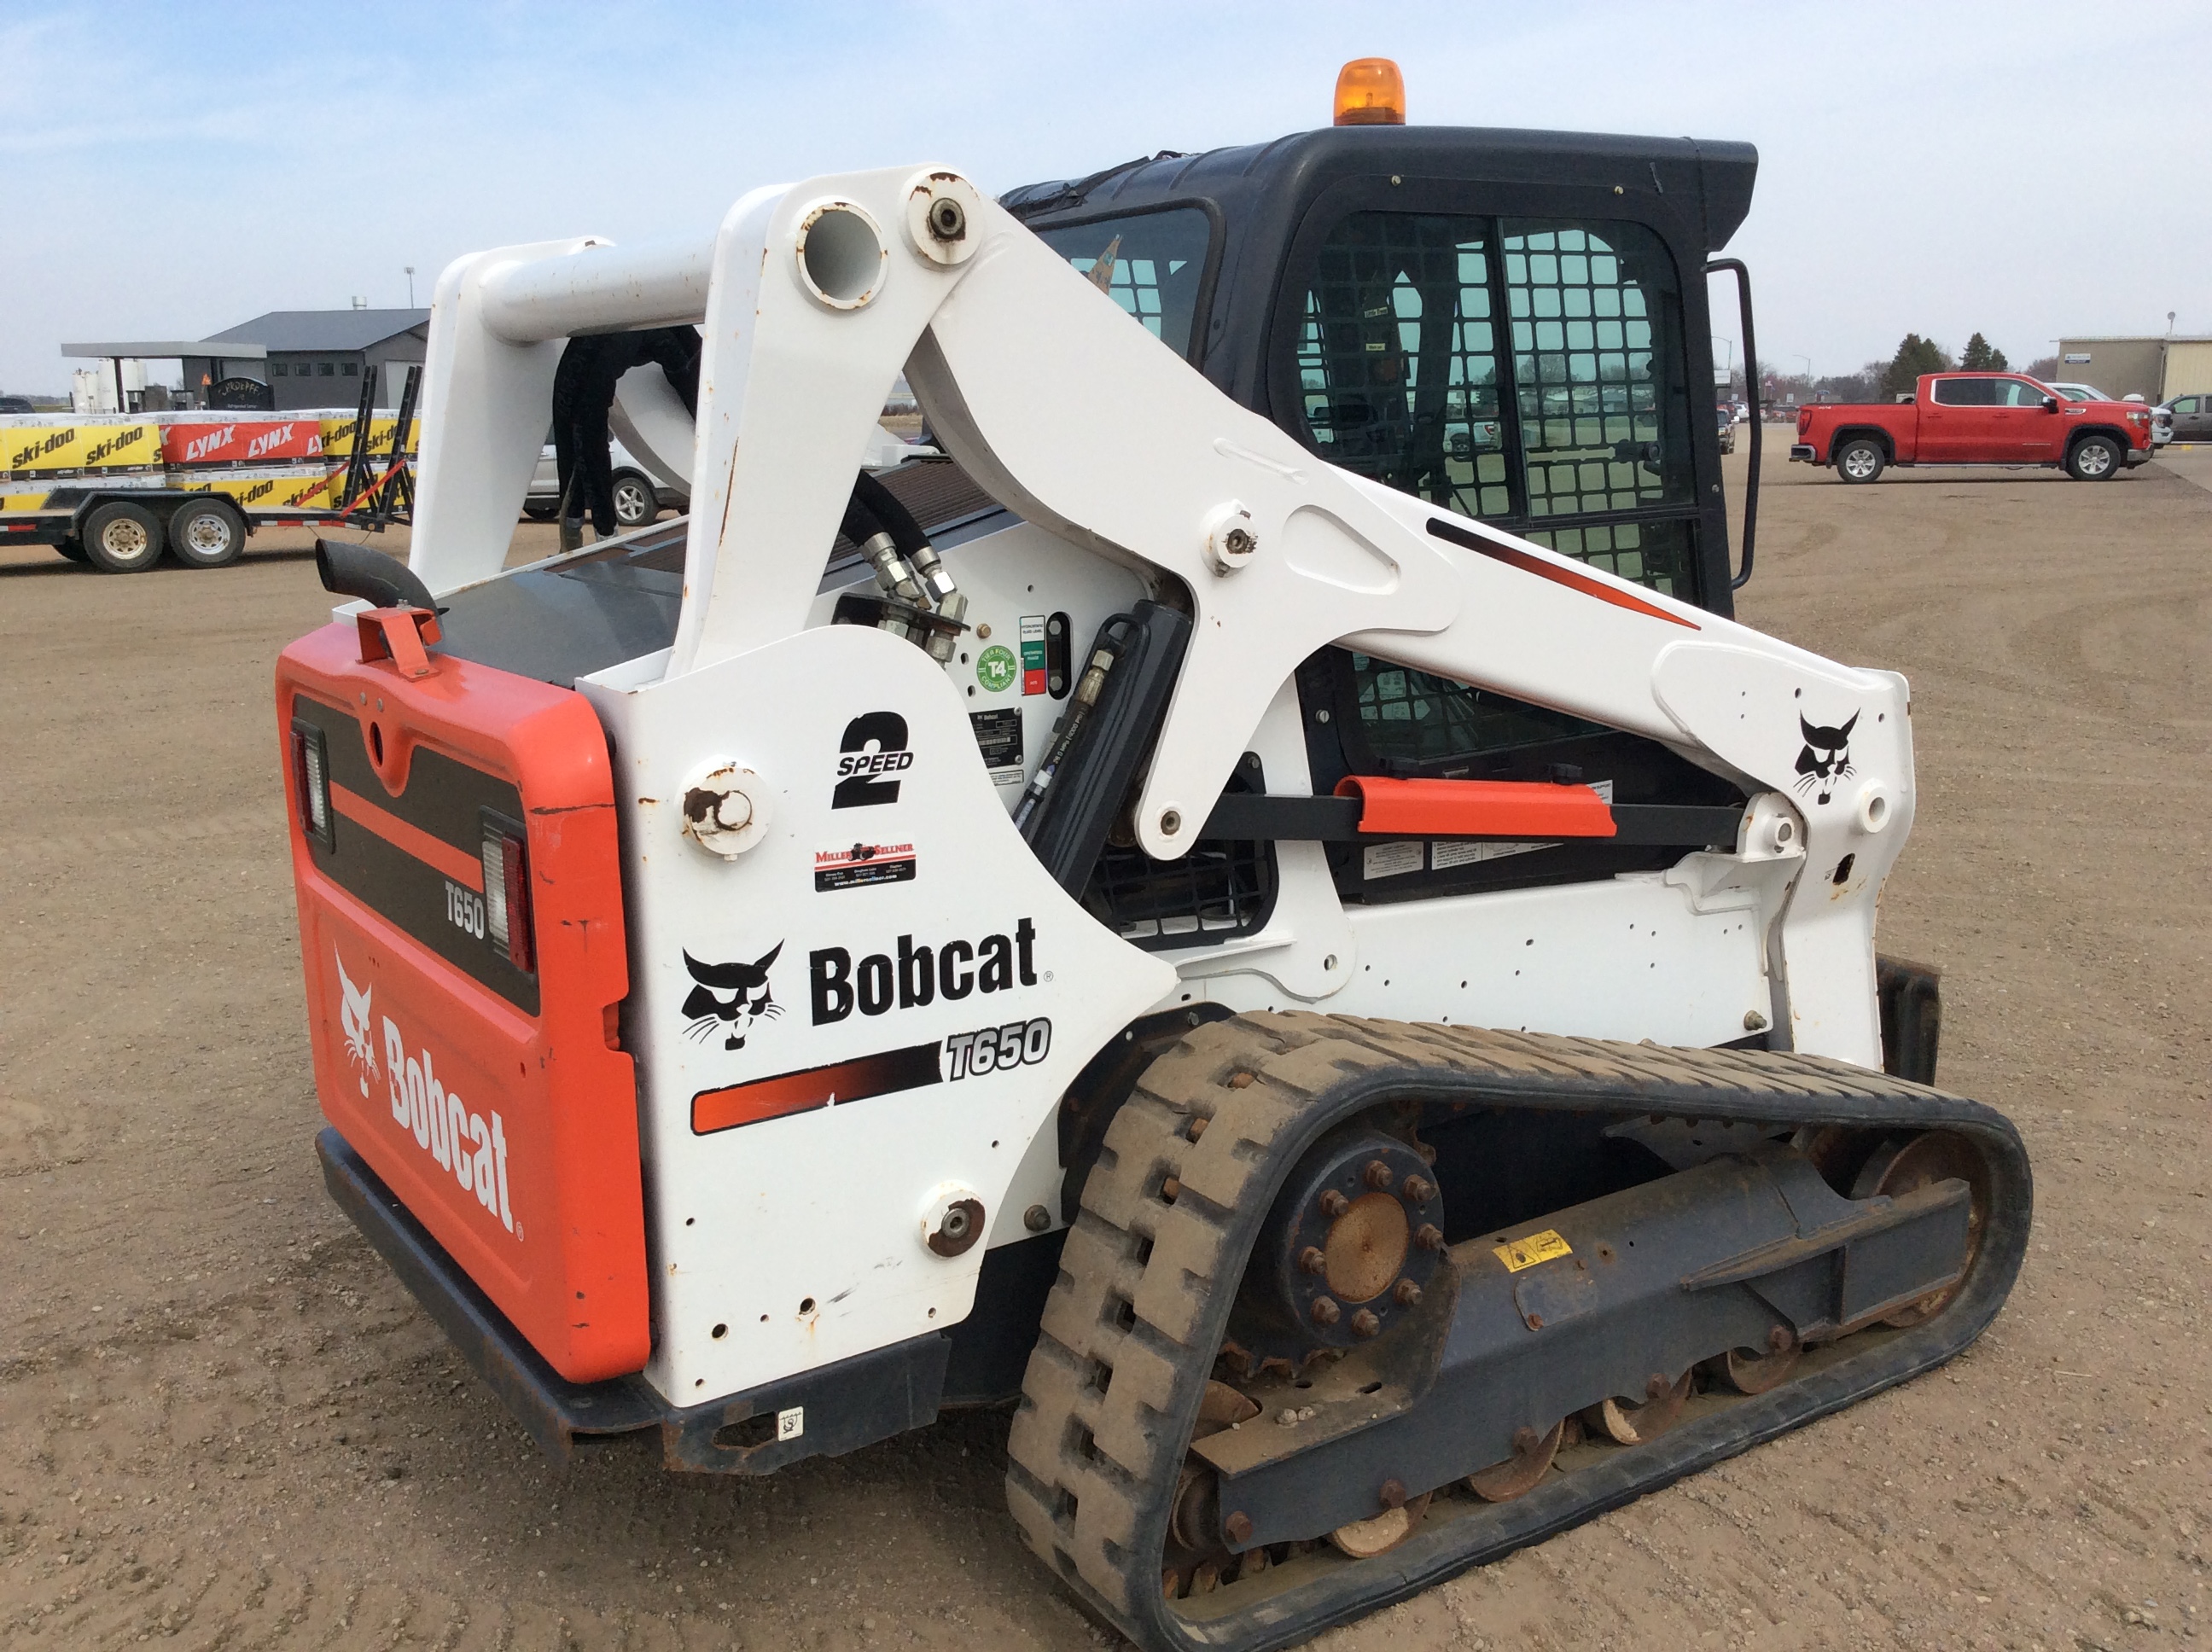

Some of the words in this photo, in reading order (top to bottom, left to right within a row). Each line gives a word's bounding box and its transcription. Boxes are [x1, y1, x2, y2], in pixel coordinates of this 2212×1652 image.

[12, 428, 75, 468] ski-doo
[85, 427, 143, 465] ski-doo
[186, 424, 236, 461] LYNX
[247, 422, 294, 458] LYNX
[982, 649, 994, 662] TIER
[995, 649, 1011, 660] FOUR
[987, 660, 1007, 678] T4
[981, 674, 1013, 689] COMPLIANT
[831, 711, 909, 810] 2
[836, 752, 914, 777] SPEED
[816, 851, 853, 864] MILLER
[873, 843, 913, 857] SELLNER
[445, 880, 485, 940] T650
[809, 917, 1038, 1027] Bobcat
[946, 1016, 1052, 1082] T650
[382, 1015, 514, 1234] Bobcat
